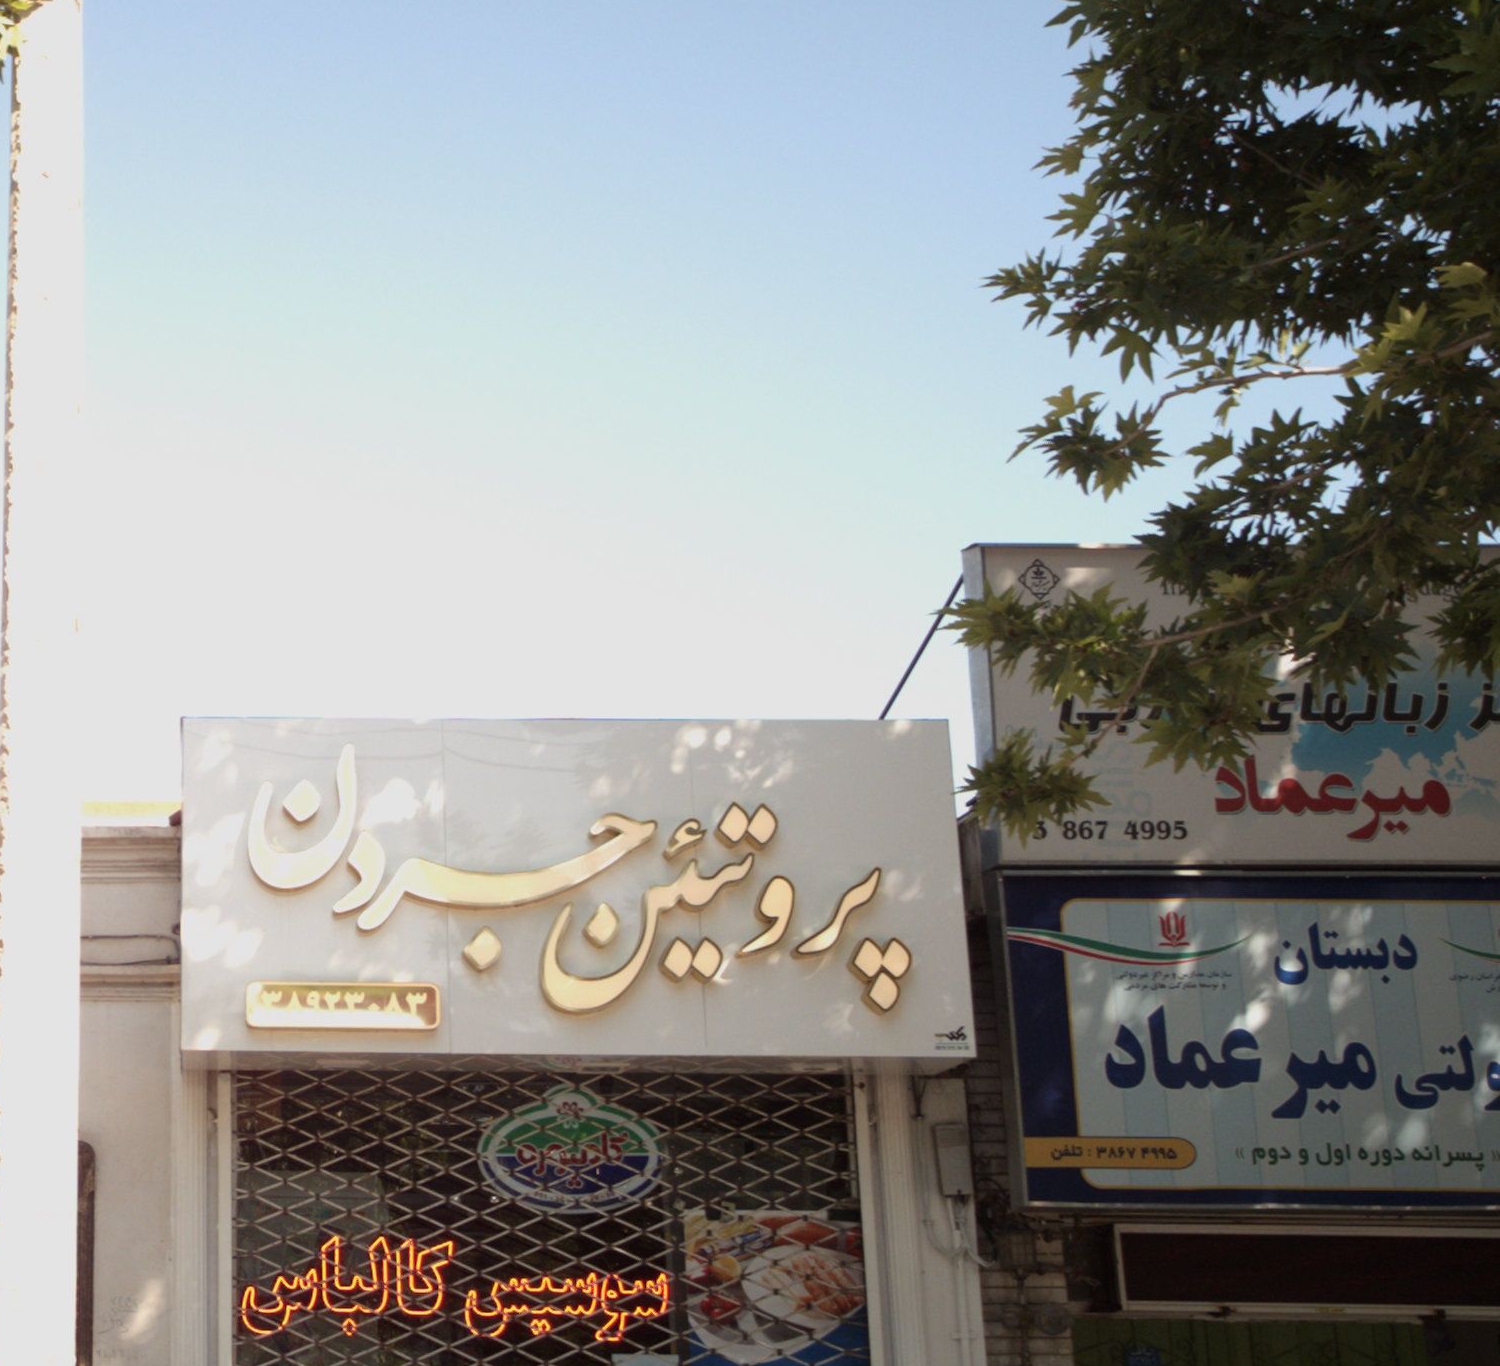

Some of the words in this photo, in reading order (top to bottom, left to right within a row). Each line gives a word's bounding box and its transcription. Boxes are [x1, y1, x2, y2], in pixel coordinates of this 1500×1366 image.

[1063, 821, 1109, 840] 867
[1124, 821, 1188, 840] 4995
[539, 802, 913, 1014] پروتئین
[1274, 922, 1418, 985] دبستان
[1050, 1144, 1083, 1161] تلفن
[1251, 1145, 1291, 1165] دوم
[1298, 1146, 1309, 1165] و
[1315, 1143, 1352, 1166] اول
[1358, 1146, 1405, 1167] دوره
[1412, 1145, 1484, 1171] پسرانه
[241, 1233, 456, 1337] کالباس
[465, 1271, 670, 1343] سوسیس
